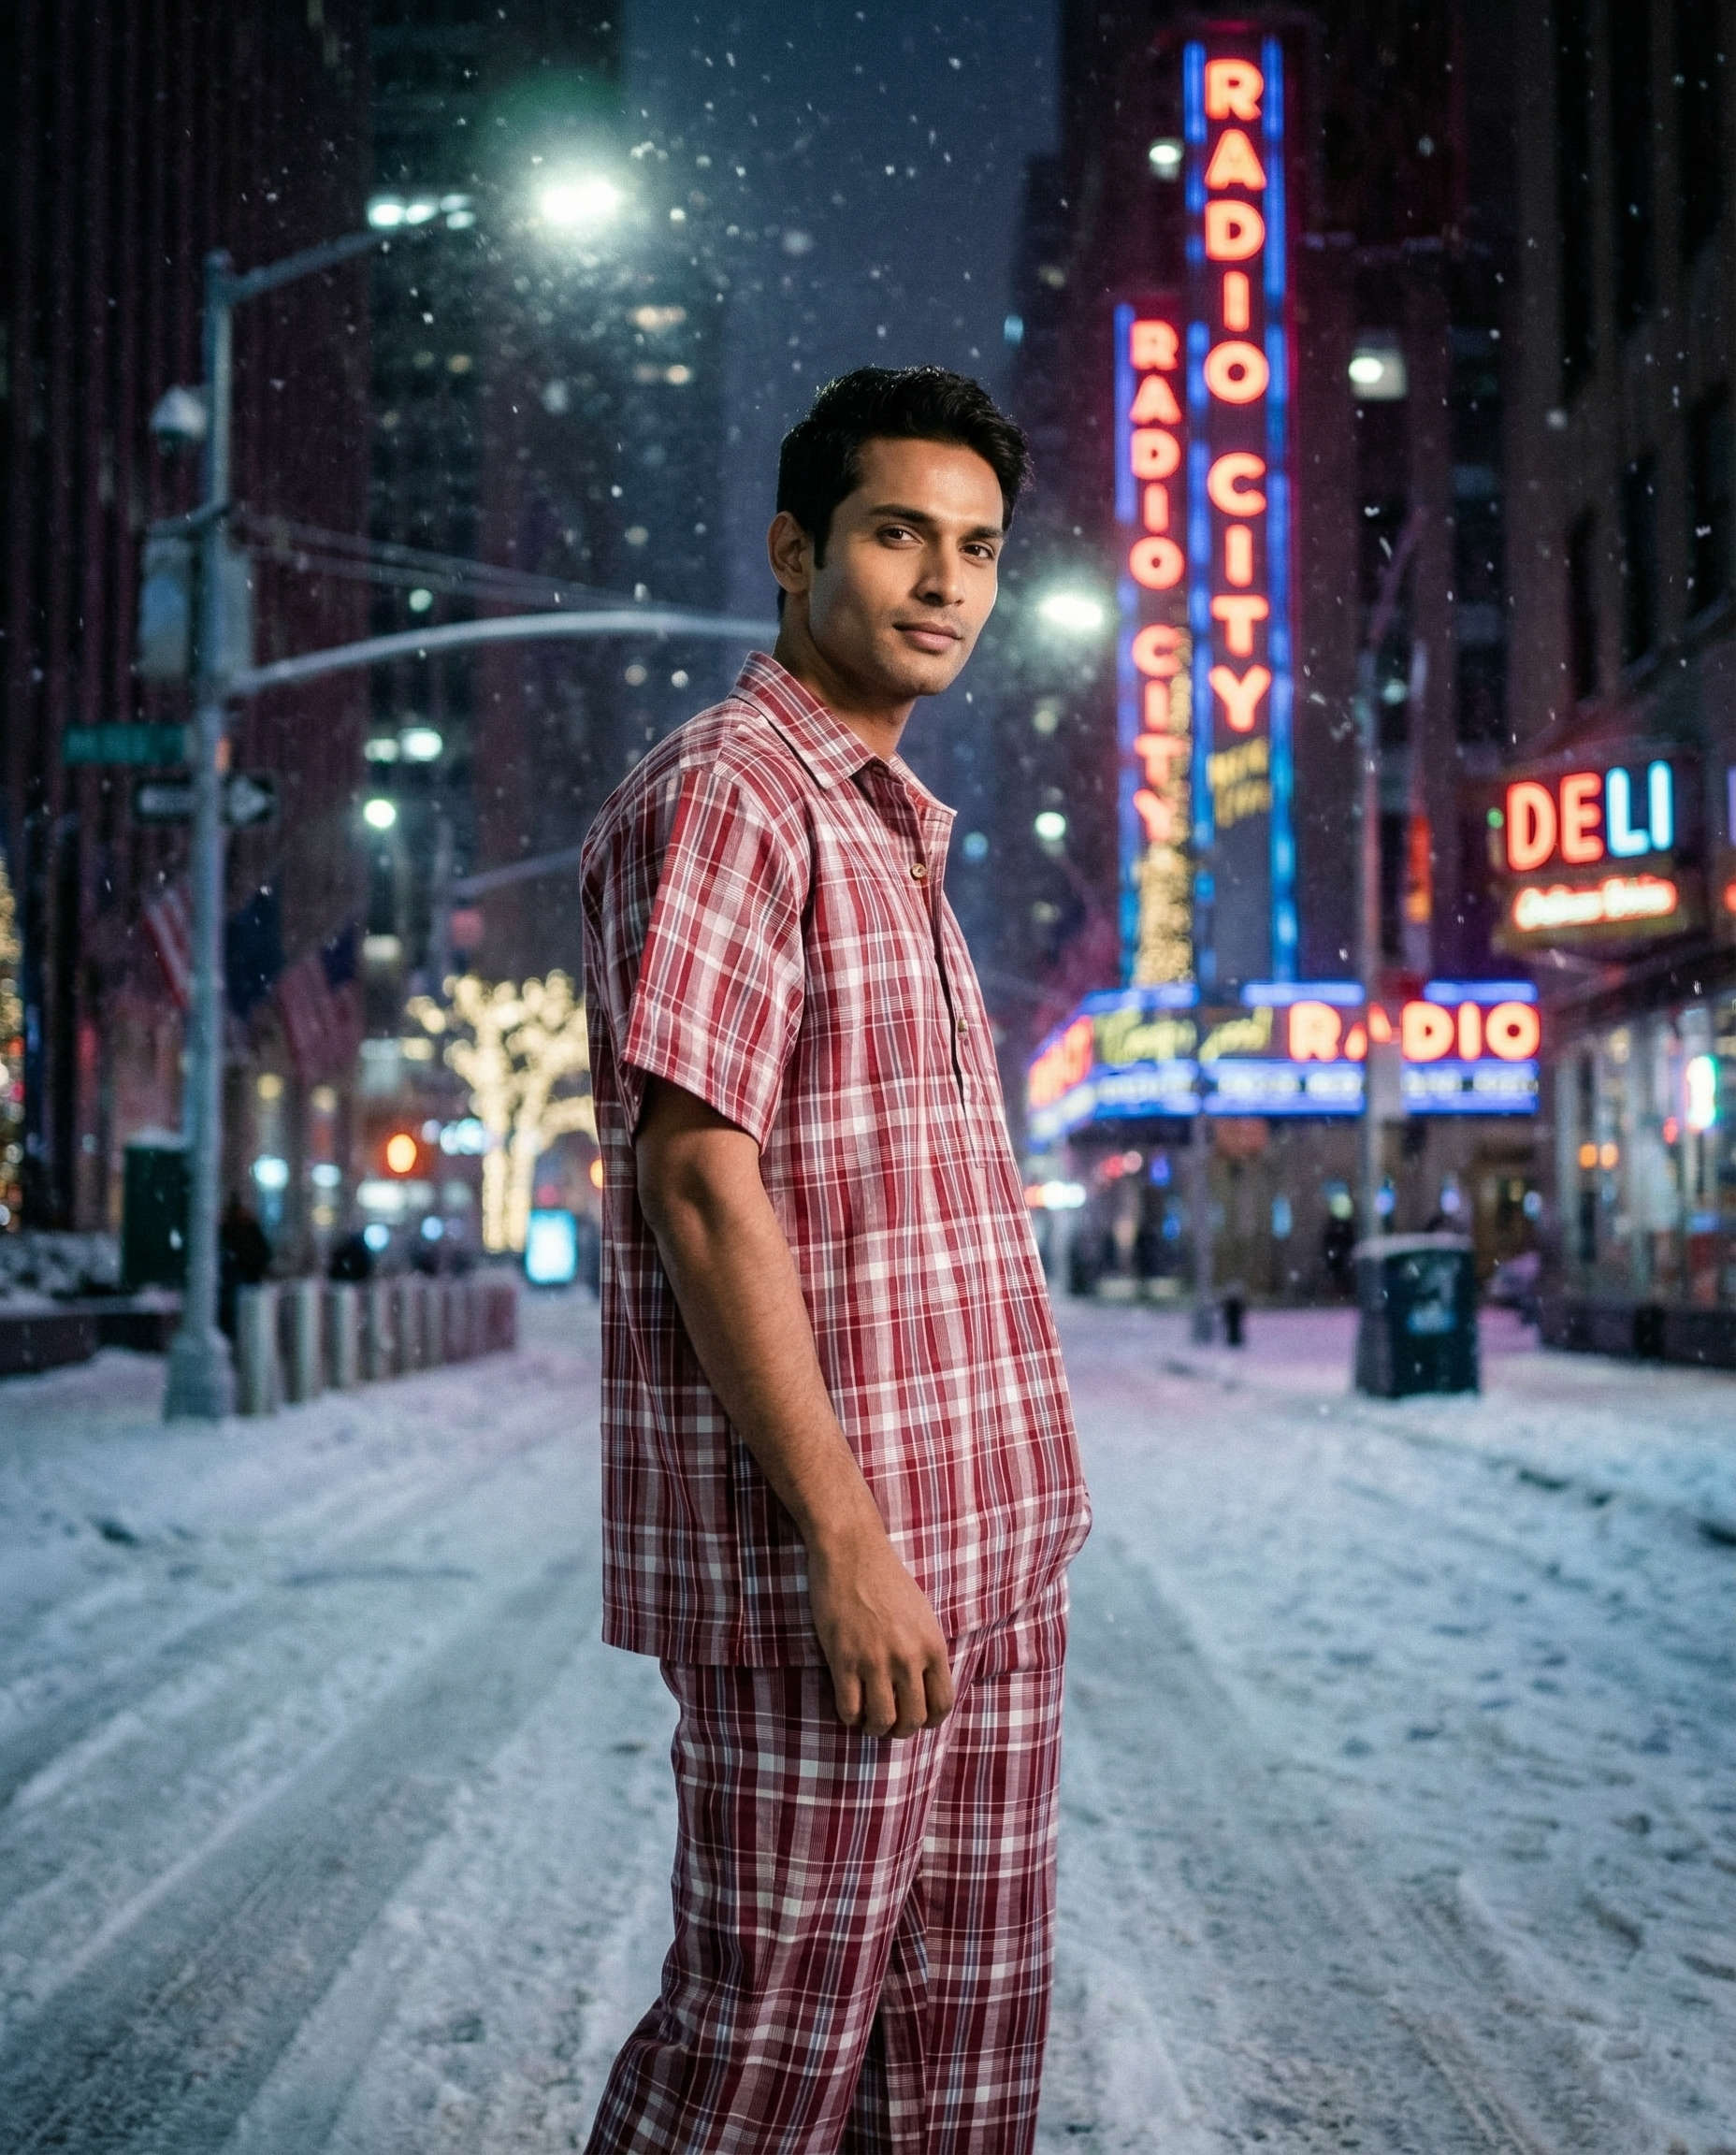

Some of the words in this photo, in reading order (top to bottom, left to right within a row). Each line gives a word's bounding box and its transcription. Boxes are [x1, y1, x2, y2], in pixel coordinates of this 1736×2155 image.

[1205, 58, 1270, 405] RADIO
[1129, 319, 1185, 590] RADIO
[1208, 452, 1272, 731] CITY
[1132, 624, 1189, 843] CITY
[1507, 759, 1674, 872] DELI
